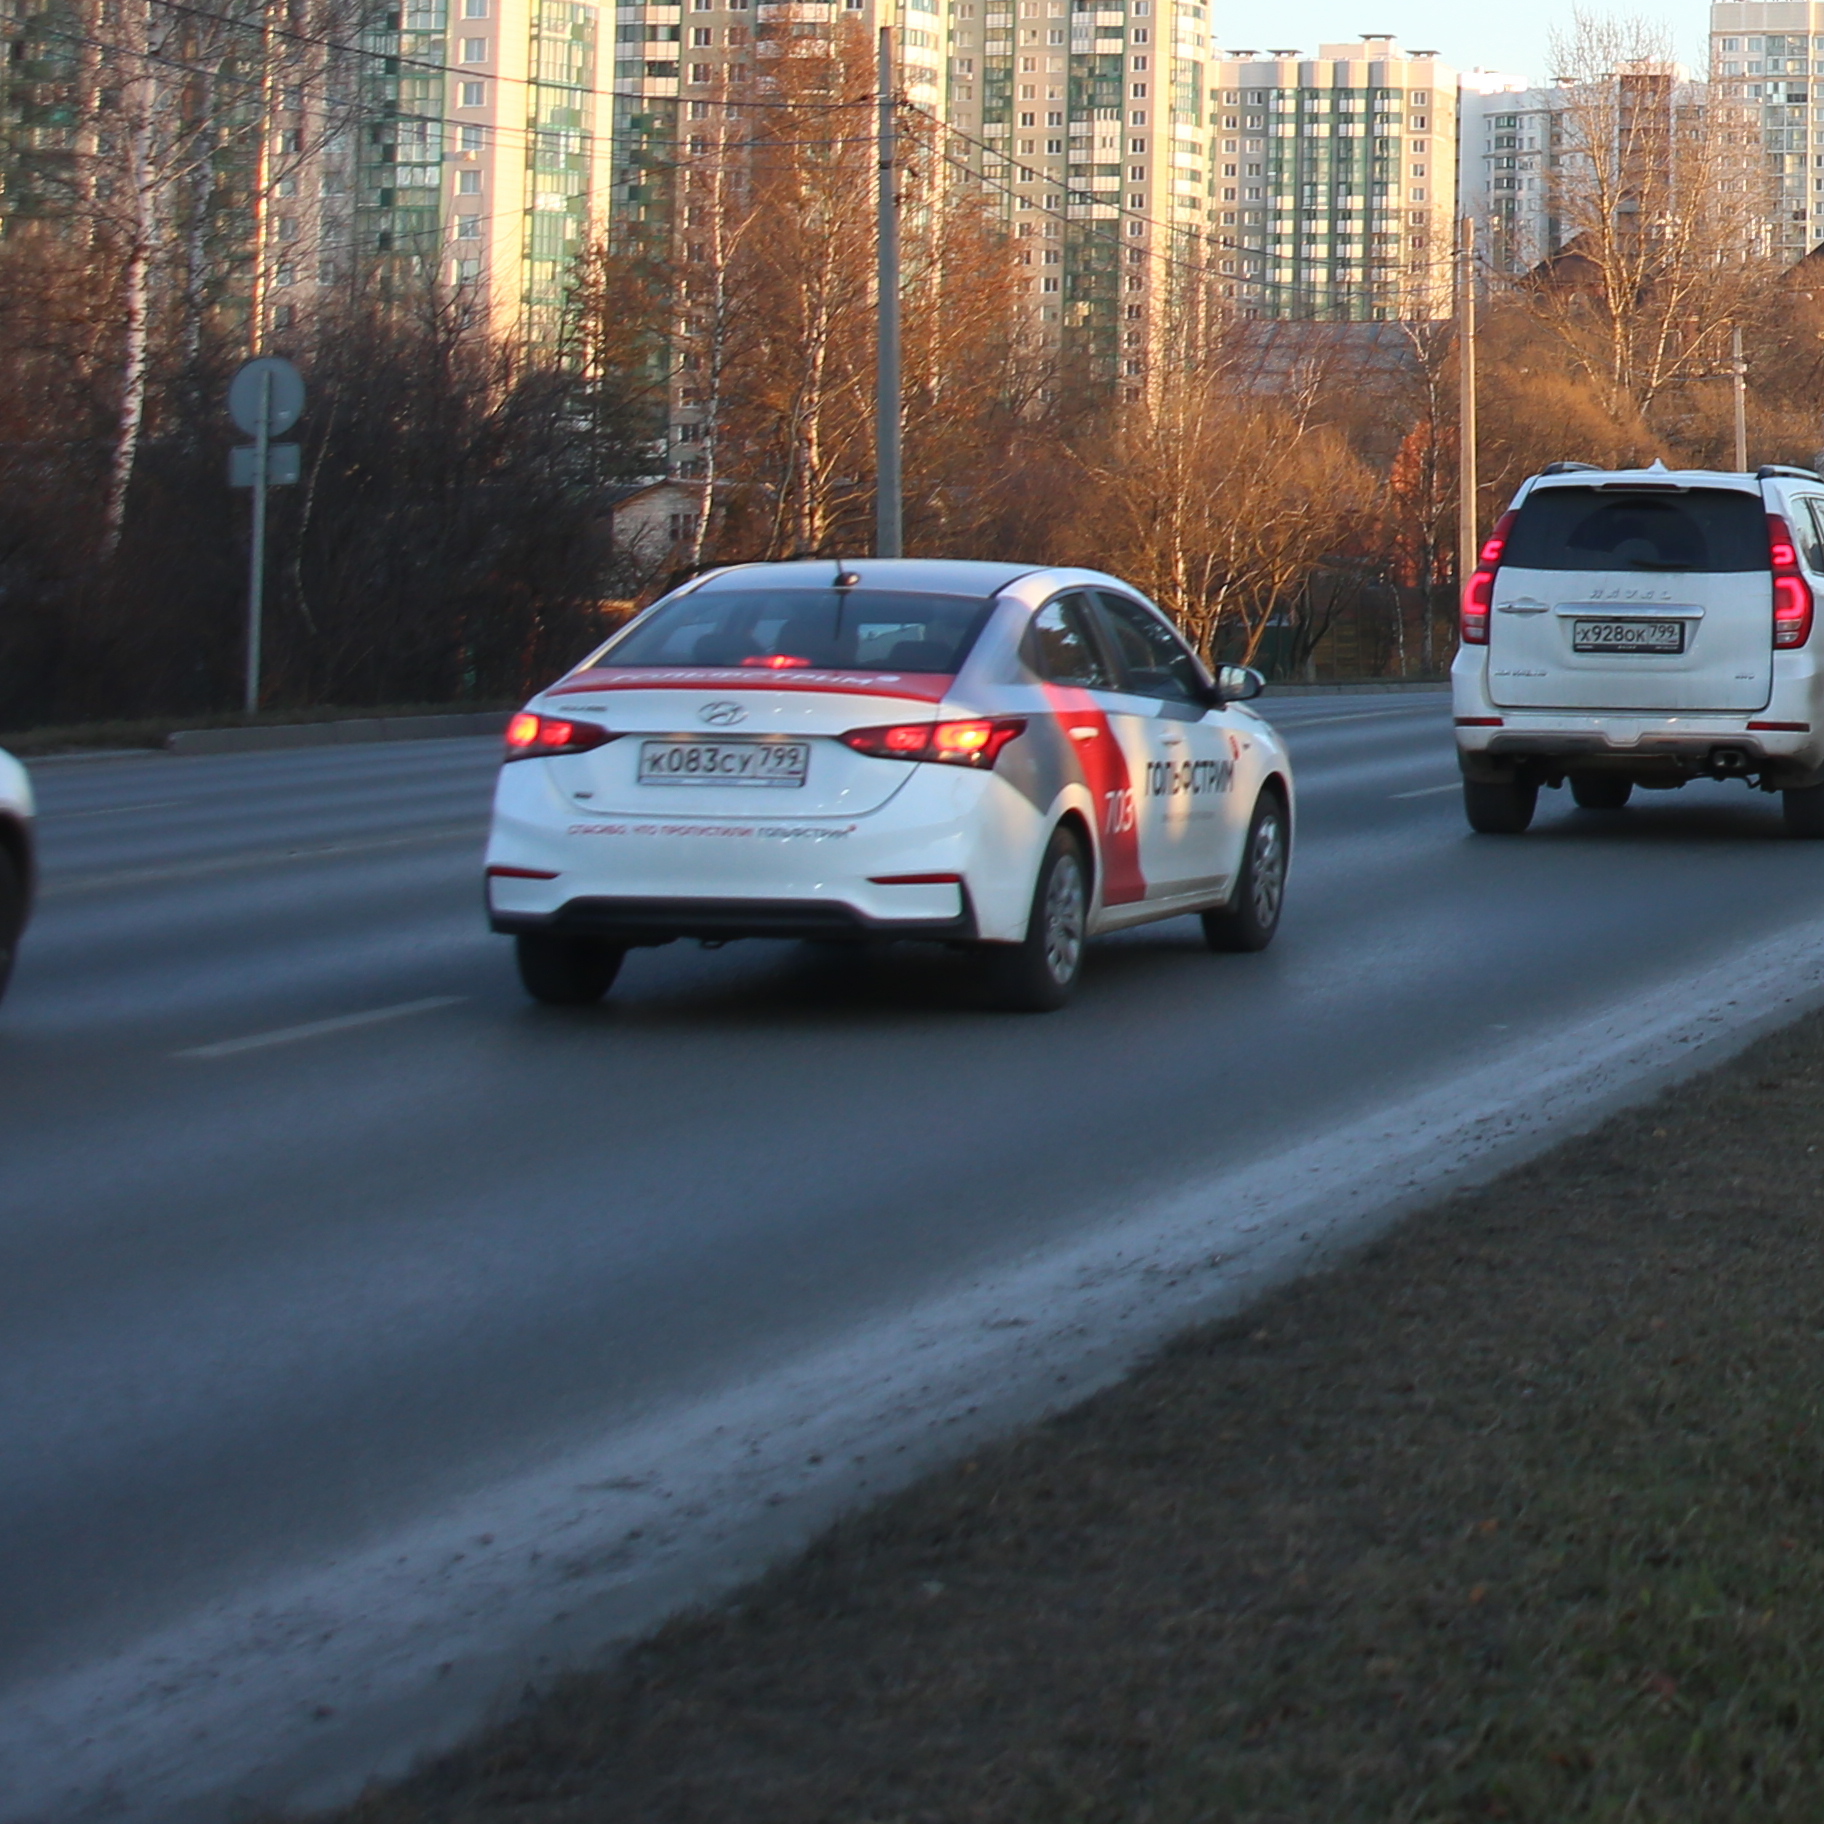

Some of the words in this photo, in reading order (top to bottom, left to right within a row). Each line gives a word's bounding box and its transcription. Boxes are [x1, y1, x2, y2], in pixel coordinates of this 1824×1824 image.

[1650, 624, 1675, 638] 799
[758, 746, 799, 767] 799
[1145, 759, 1234, 796] ГОЛЬФСТРИМ
[1104, 788, 1135, 835] 703
